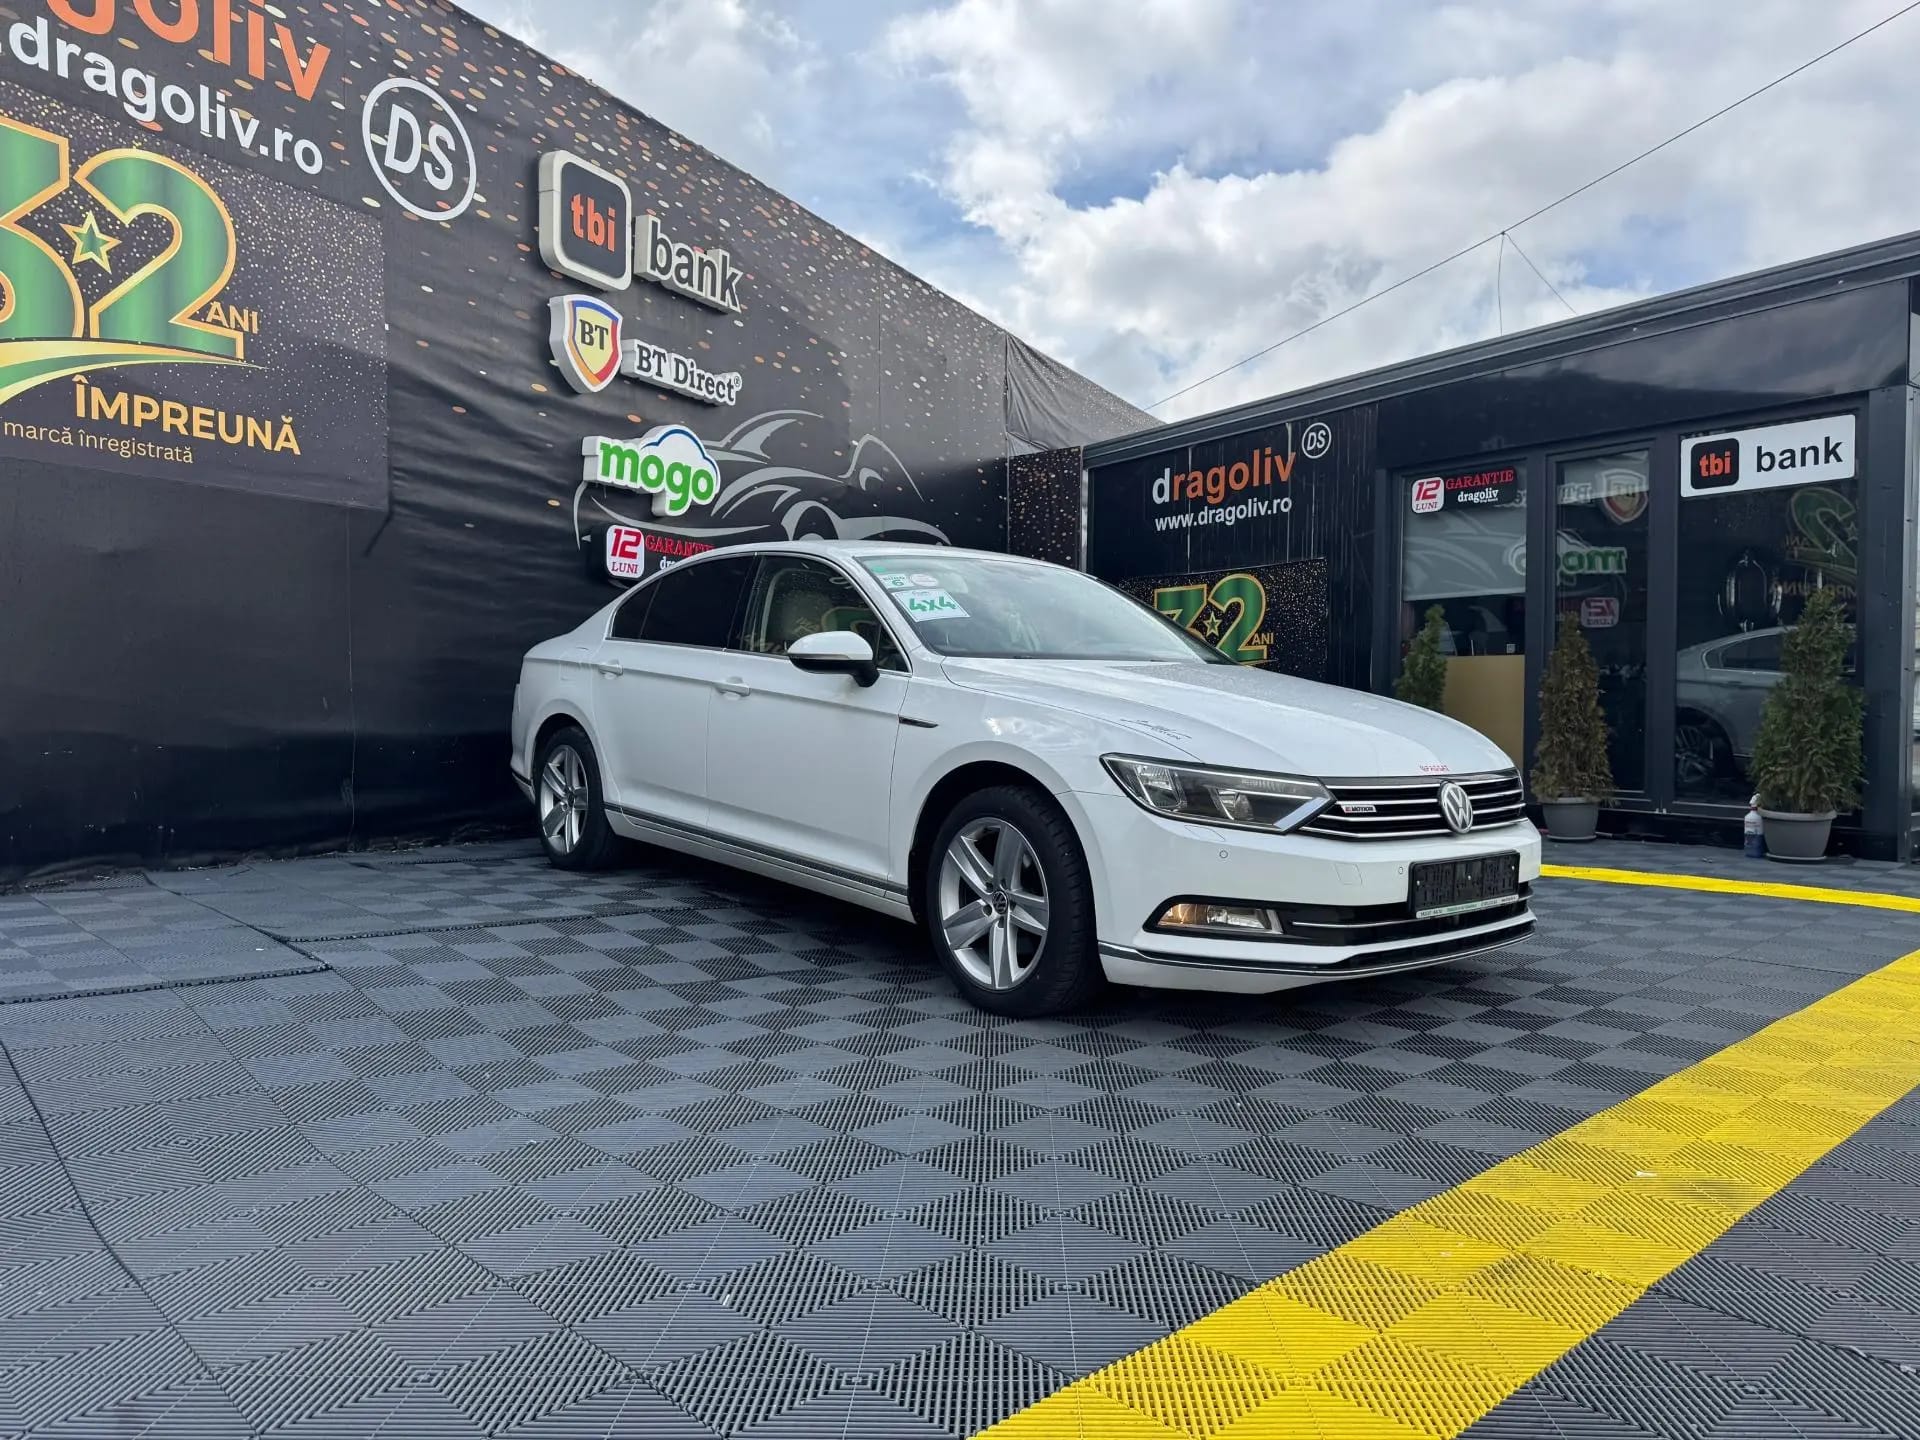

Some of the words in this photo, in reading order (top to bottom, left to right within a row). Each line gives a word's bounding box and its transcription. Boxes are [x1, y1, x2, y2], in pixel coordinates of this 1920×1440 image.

[0, 16, 323, 175] dragoliv.ro
[384, 103, 456, 191] DS
[571, 193, 616, 252] tbi
[649, 218, 740, 310] bank
[205, 301, 259, 334] ANI
[579, 318, 609, 350] BT
[636, 343, 667, 378] BT
[72, 374, 301, 455] ÎMPREUNĂ
[4, 420, 74, 446] marcă
[79, 429, 194, 464] înregistrată
[1306, 429, 1327, 451] DS
[1699, 451, 1732, 477] tbi
[1756, 436, 1844, 473] bank
[600, 441, 714, 512] mogo
[1152, 447, 1297, 505] dragoliv
[1415, 479, 1441, 501] 12
[1445, 469, 1514, 490] GARANTIE
[1415, 501, 1438, 511] LUNI
[1457, 487, 1499, 504] dragoliv
[1155, 497, 1292, 532] www.dragoliv.ro
[611, 528, 642, 560] 12
[612, 561, 639, 575] LUNI
[1251, 632, 1275, 646] ANI
